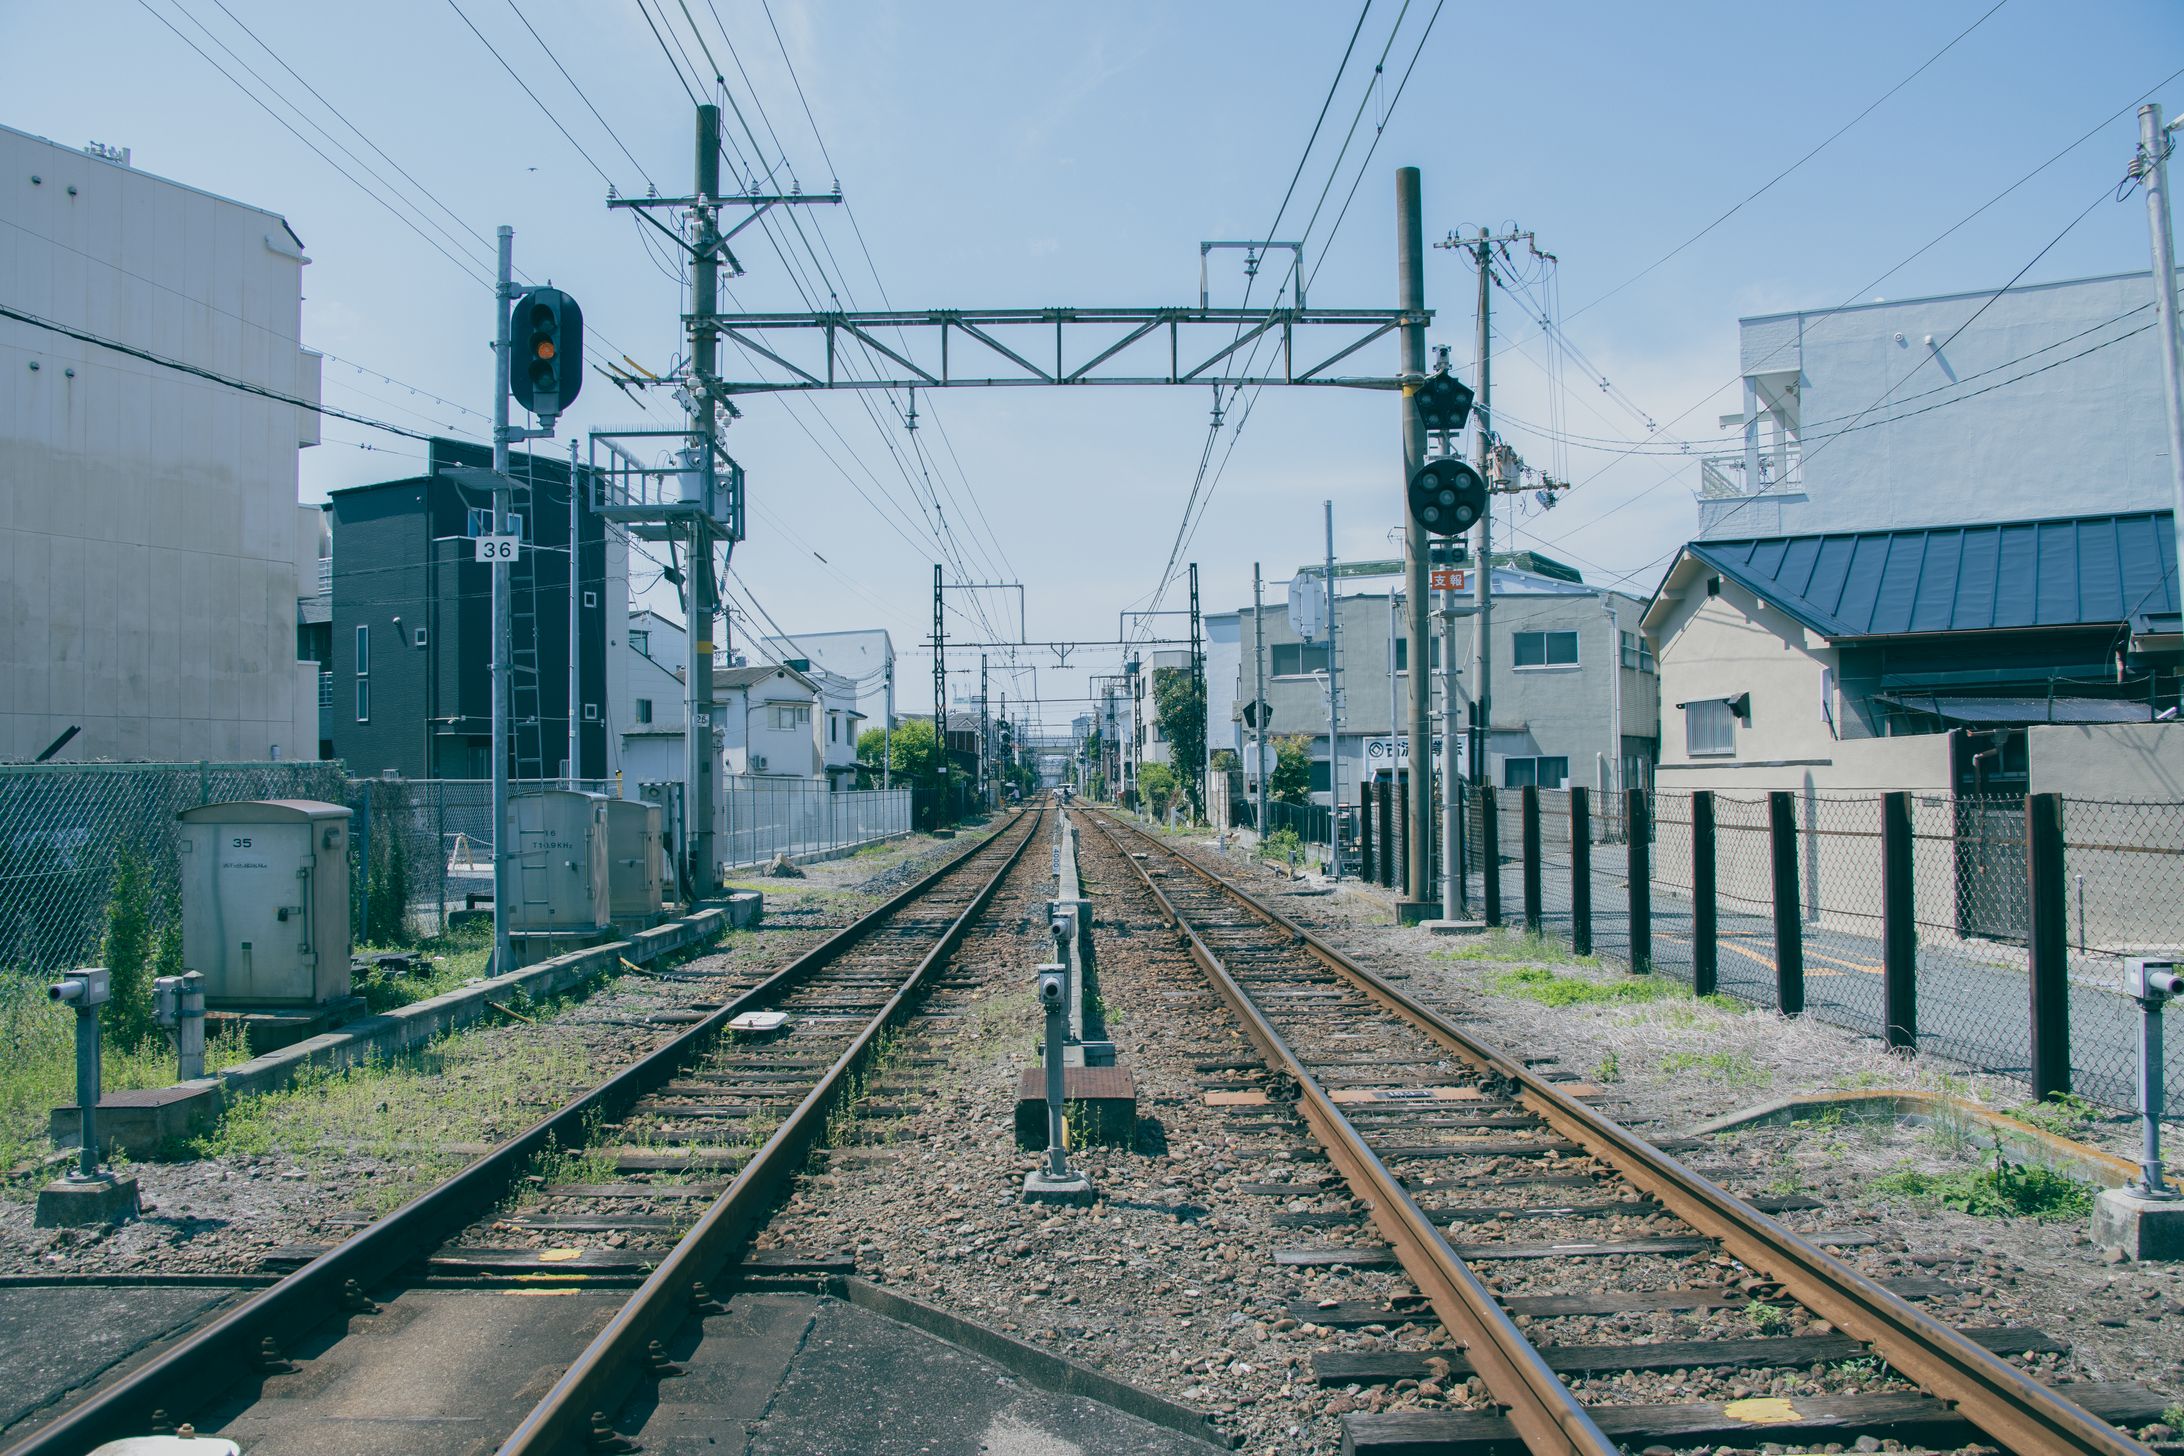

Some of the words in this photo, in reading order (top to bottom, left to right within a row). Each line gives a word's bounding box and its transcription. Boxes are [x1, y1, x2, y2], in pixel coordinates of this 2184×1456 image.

[484, 542, 511, 558] 36
[1434, 574, 1463, 587] 支報
[696, 715, 707, 725] 26
[233, 838, 252, 848] 35
